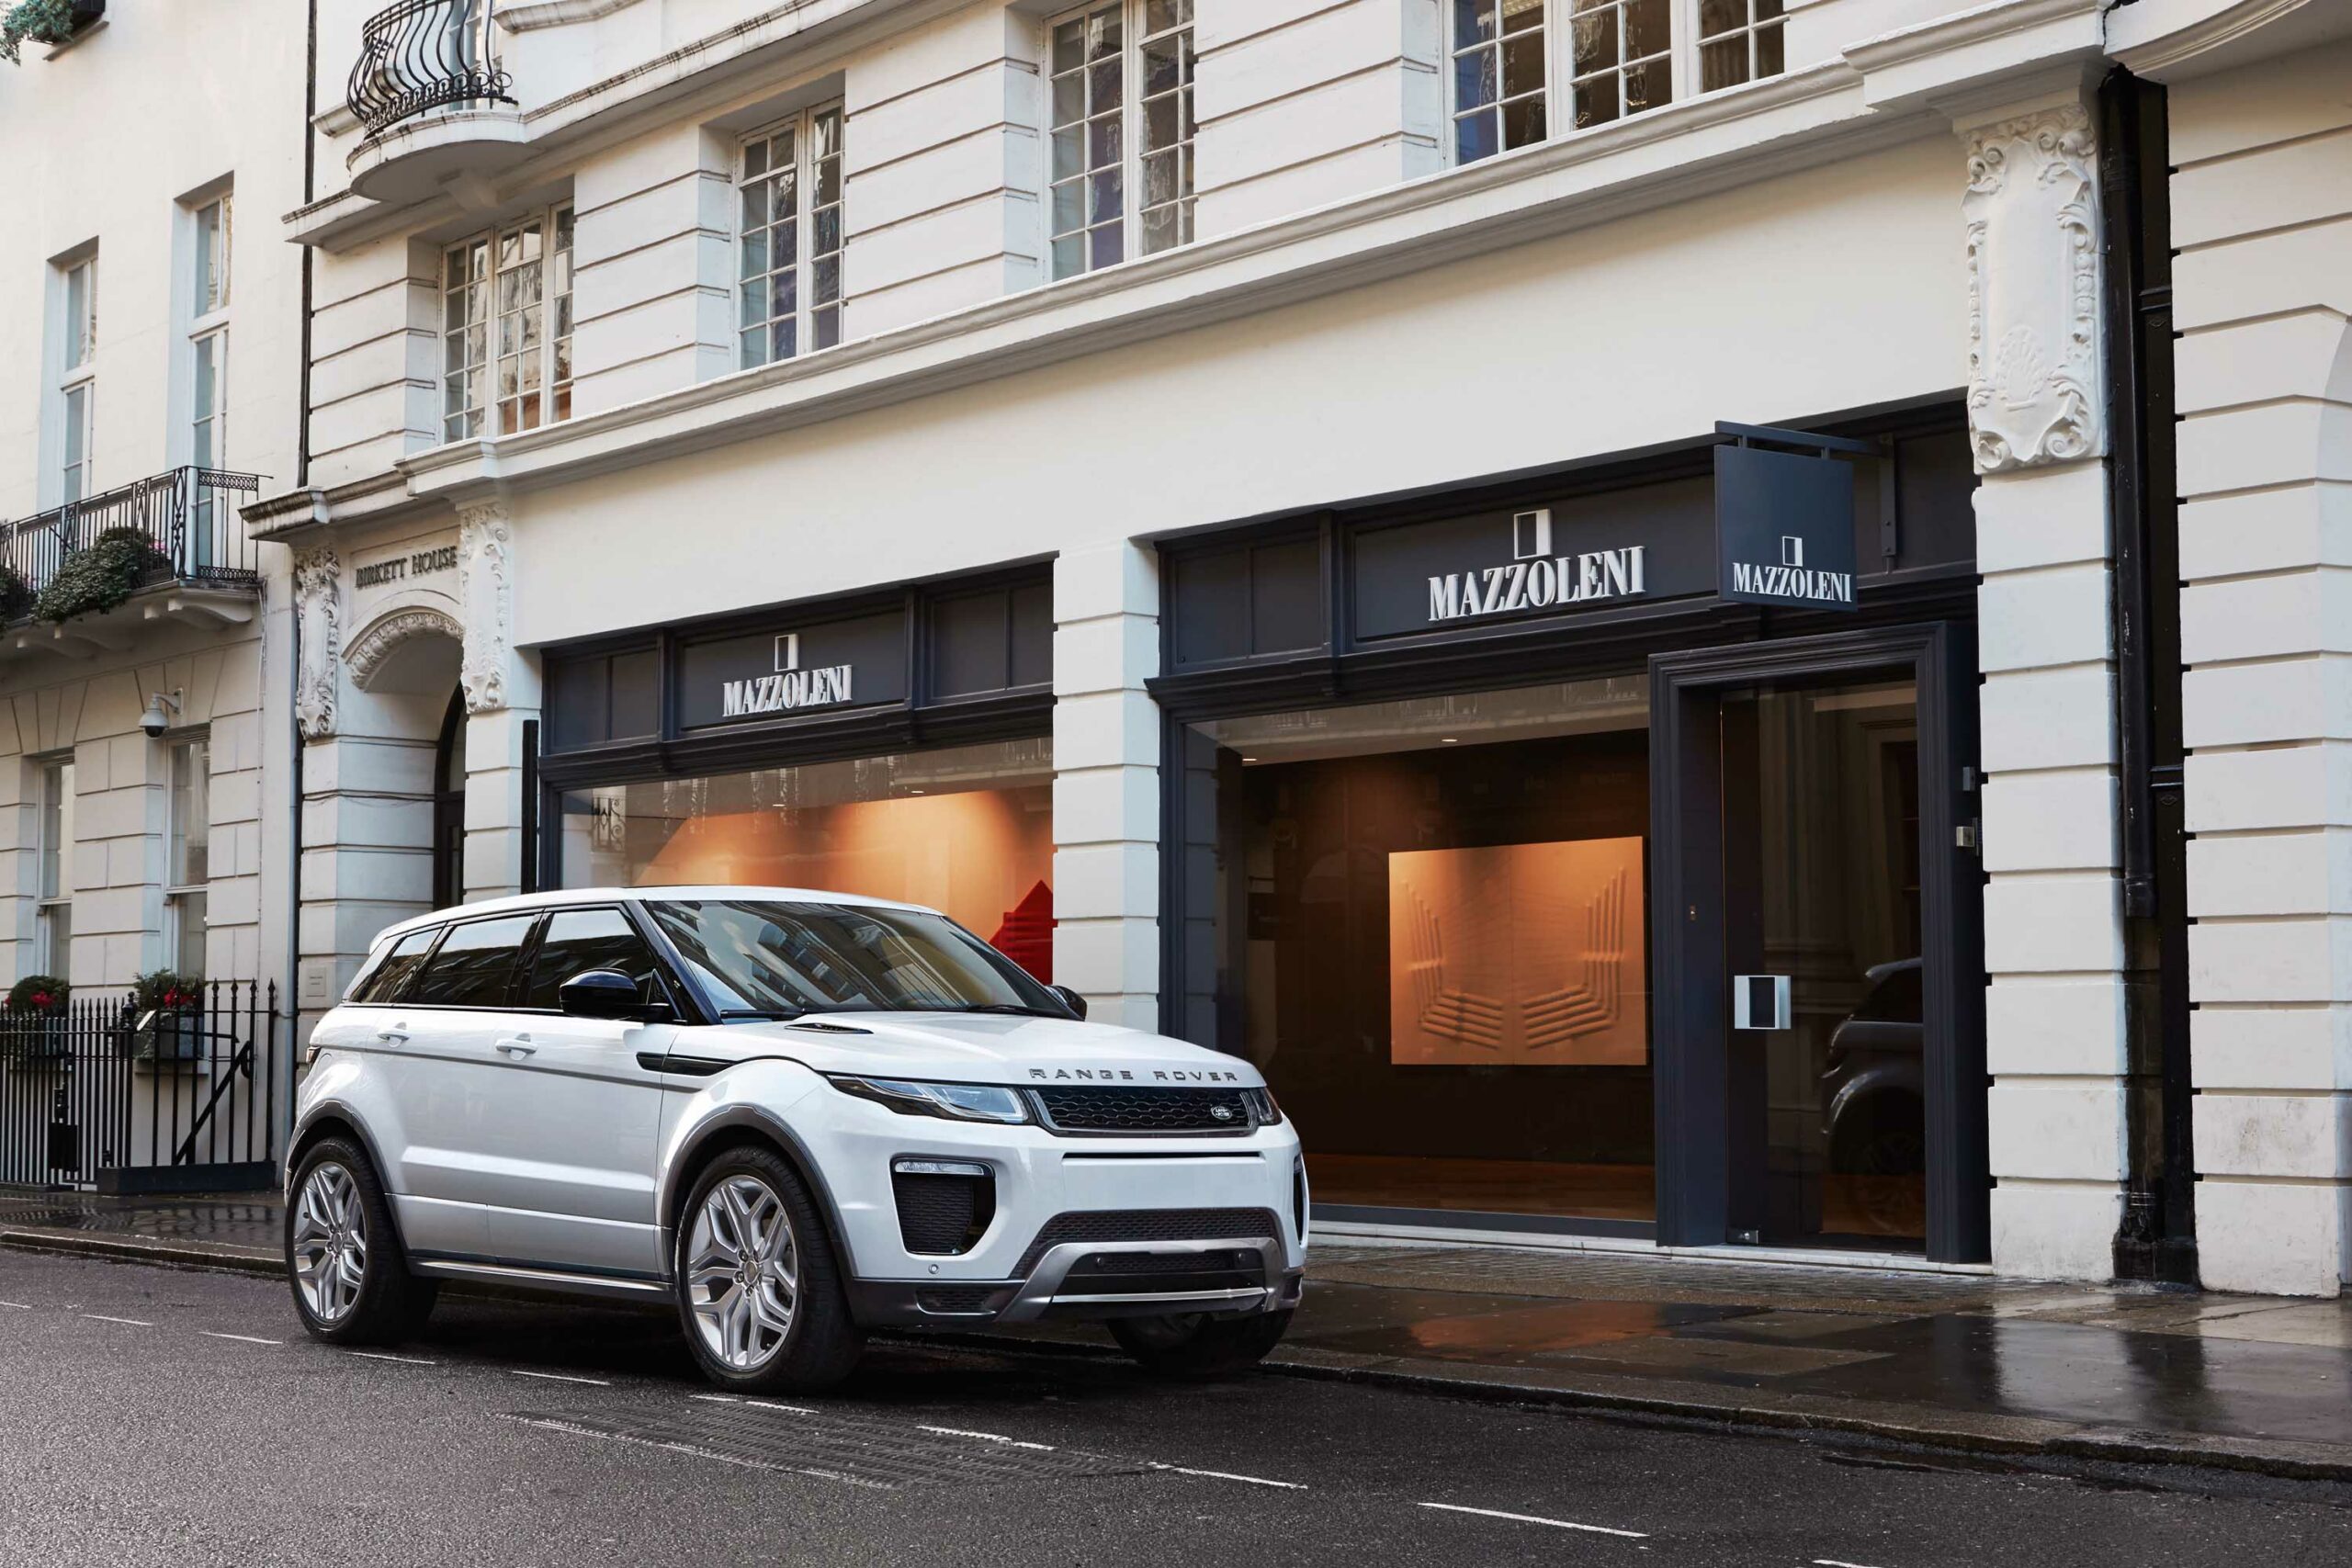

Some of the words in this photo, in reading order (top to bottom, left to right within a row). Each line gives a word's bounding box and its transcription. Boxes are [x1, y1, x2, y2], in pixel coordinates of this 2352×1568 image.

[356, 558, 407, 588] BIRKETT
[412, 546, 457, 575] HOUSE
[1428, 546, 1646, 621] MAZZOLENI
[1733, 562, 1852, 602] MAZZOLENI
[722, 664, 853, 716] MAZZOLENI
[1029, 1068, 1134, 1080] RANGE
[1153, 1070, 1238, 1081] ROVER
